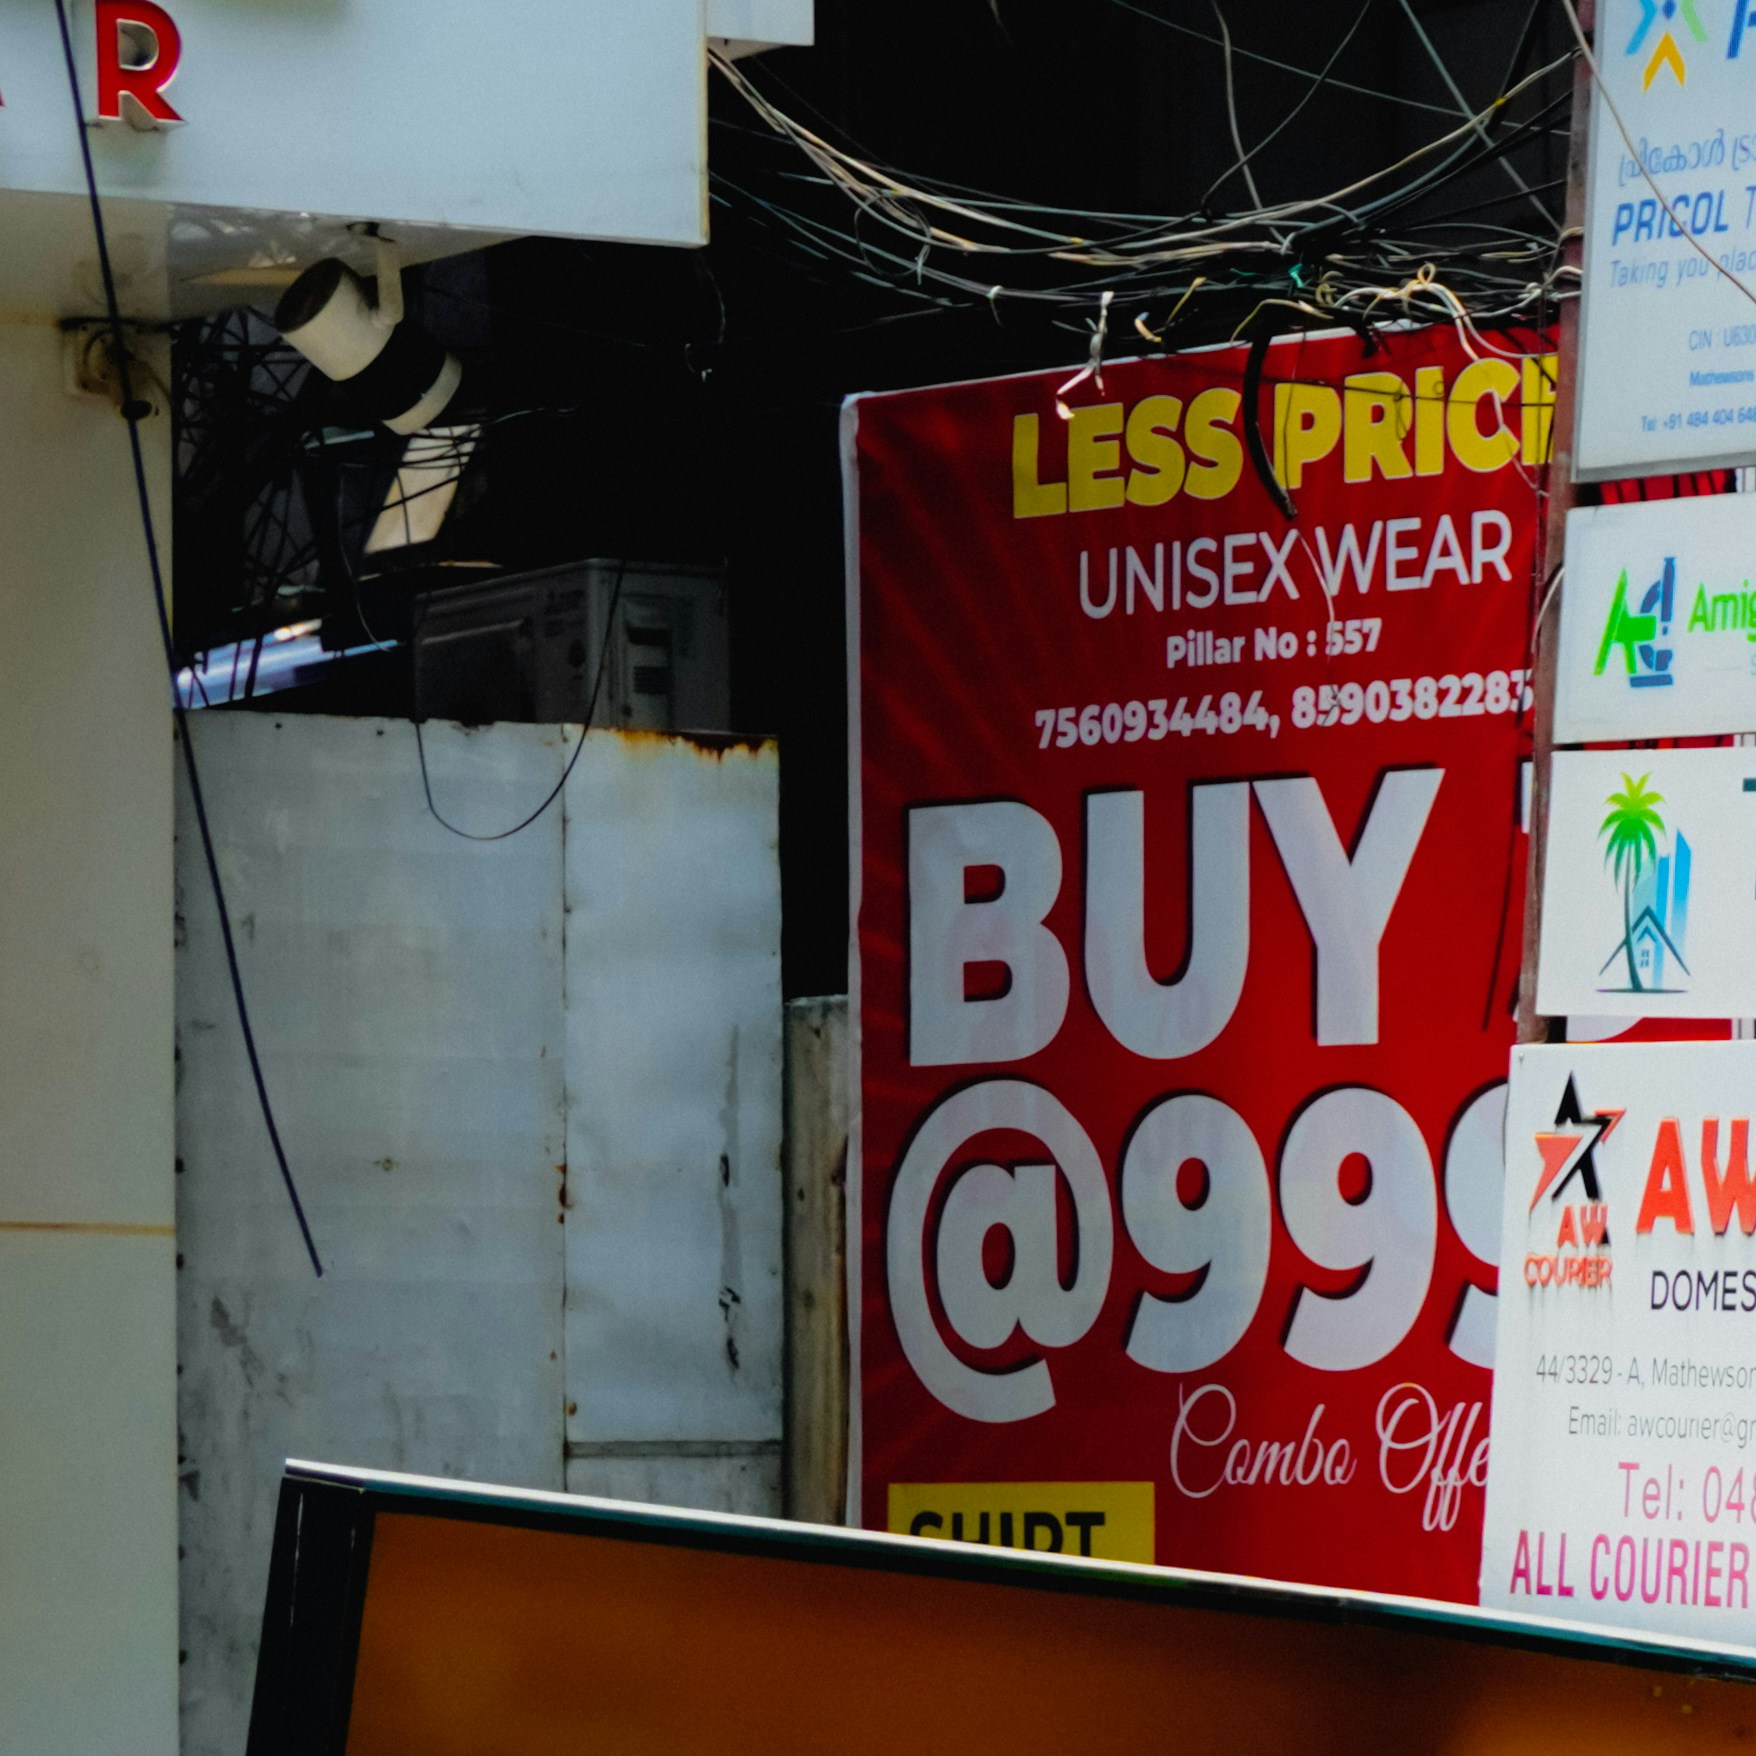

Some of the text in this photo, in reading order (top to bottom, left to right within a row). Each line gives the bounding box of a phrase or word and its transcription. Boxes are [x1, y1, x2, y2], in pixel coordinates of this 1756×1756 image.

[1611, 188, 1729, 247] PRICOL
[1610, 259, 1668, 289] Taking
[1676, 257, 1709, 286] you
[1011, 386, 1244, 520] LESS
[1079, 509, 1514, 620] UNISEX WEAR
[1166, 617, 1383, 670] Pillar No 557
[1034, 688, 1281, 750] 7560934484,
[908, 766, 1447, 1067] BUY
[1169, 1380, 1358, 1499] Combo
[1567, 1405, 1622, 1438] Email:
[1618, 1461, 1685, 1520] Tel:
[1509, 1528, 1575, 1598] ALL
[1589, 1532, 1750, 1609] COURIER
